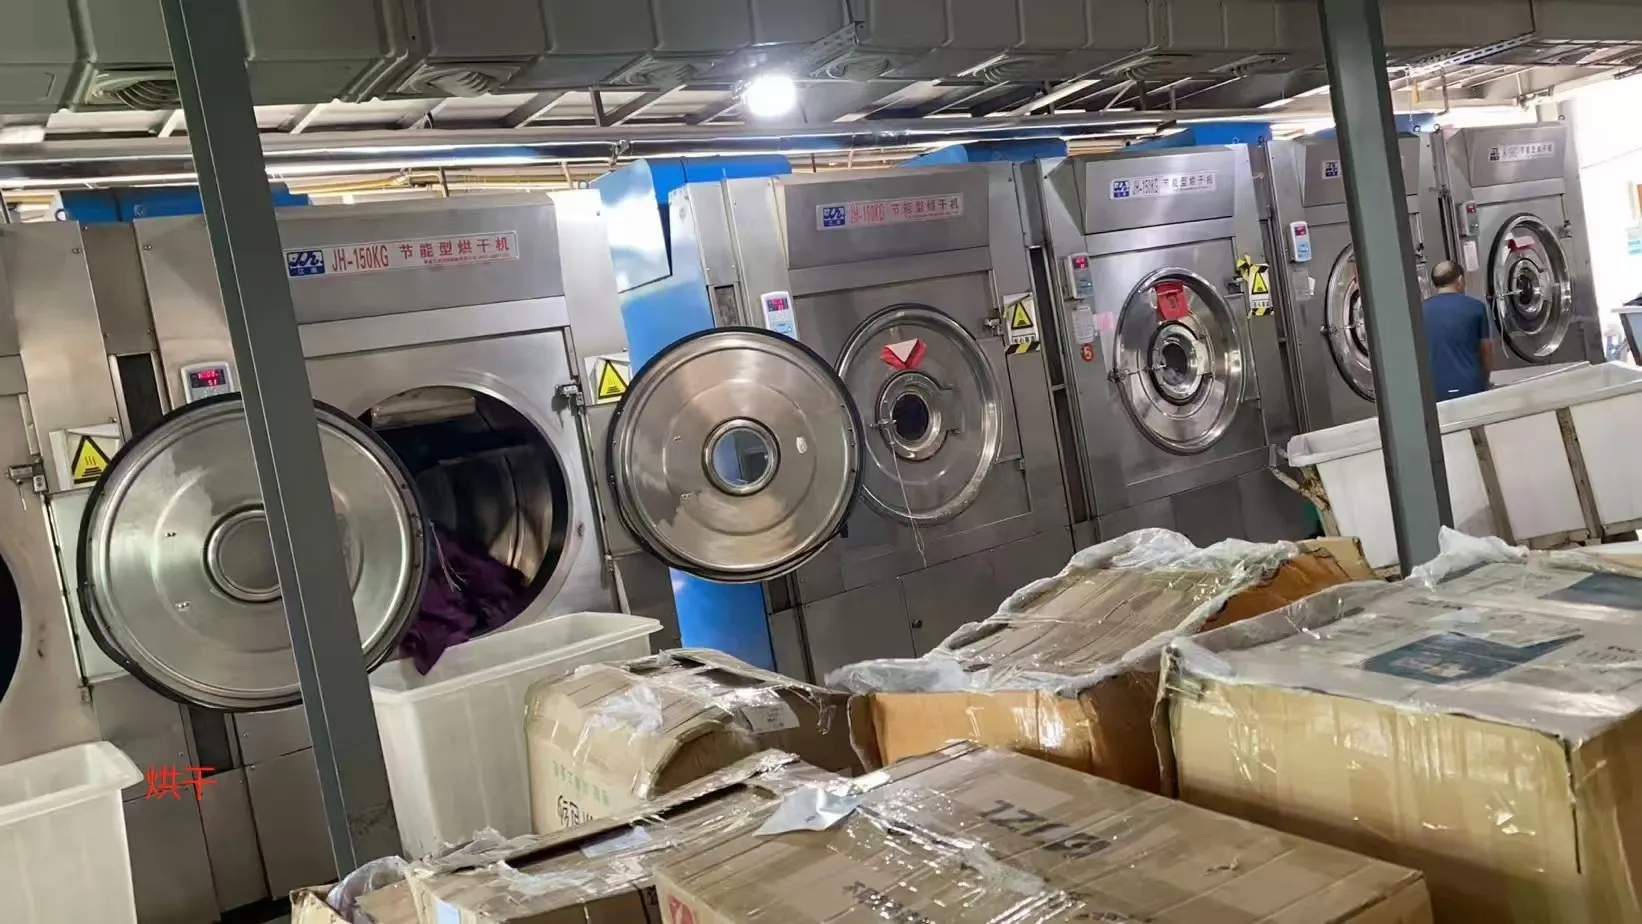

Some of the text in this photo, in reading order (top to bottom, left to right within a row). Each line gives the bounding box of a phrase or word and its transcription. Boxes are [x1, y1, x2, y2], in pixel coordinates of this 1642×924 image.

[332, 236, 510, 273] JH-150KG 节能型烘干机
